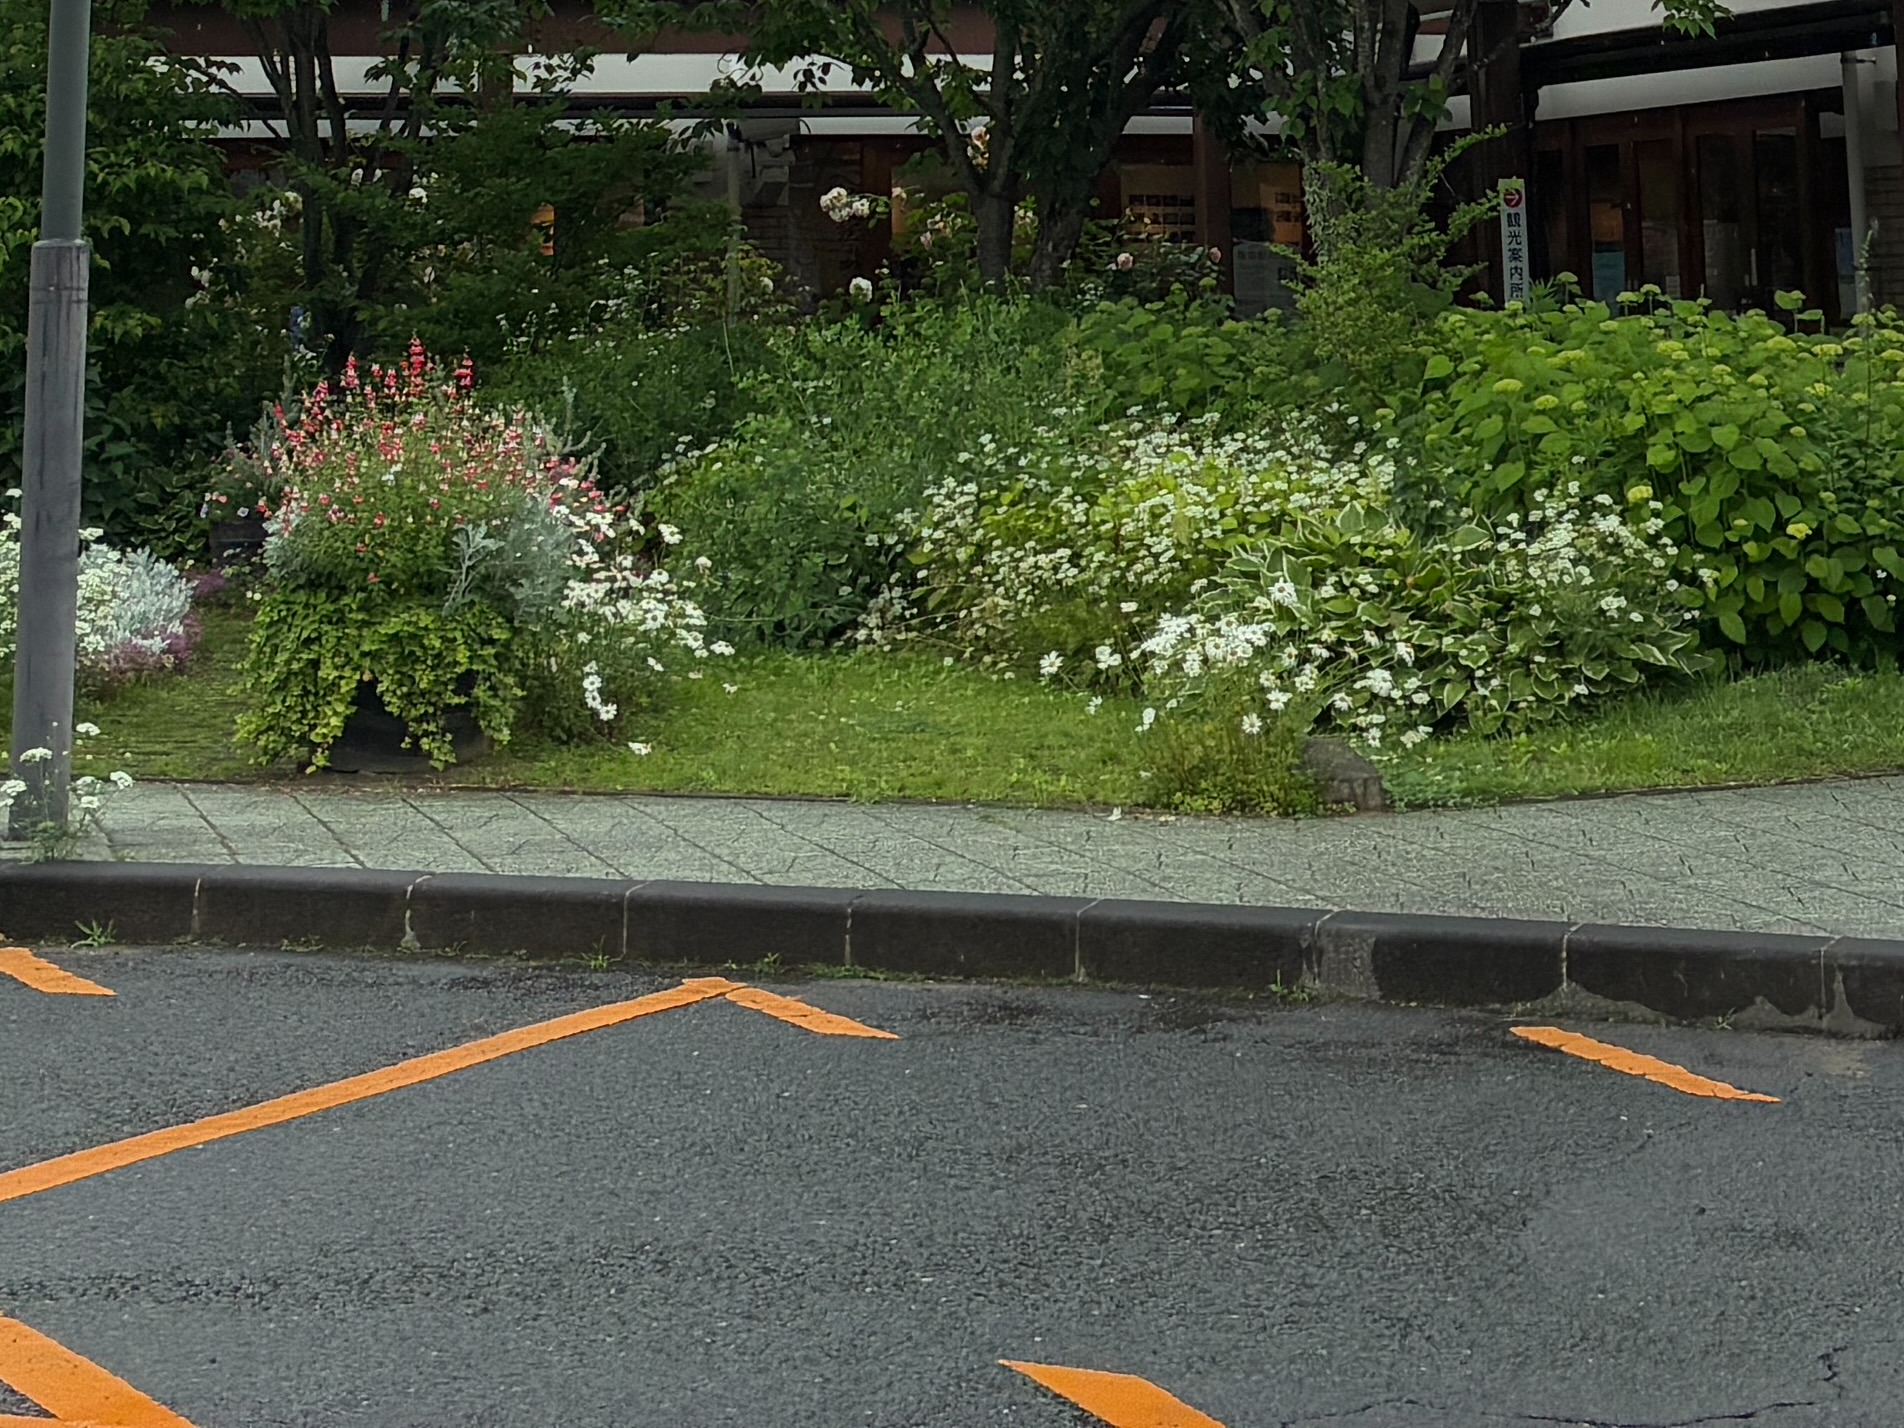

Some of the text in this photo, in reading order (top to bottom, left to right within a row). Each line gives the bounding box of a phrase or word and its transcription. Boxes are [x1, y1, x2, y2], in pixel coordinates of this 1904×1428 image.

[1506, 212, 1523, 298] 観光案内所
